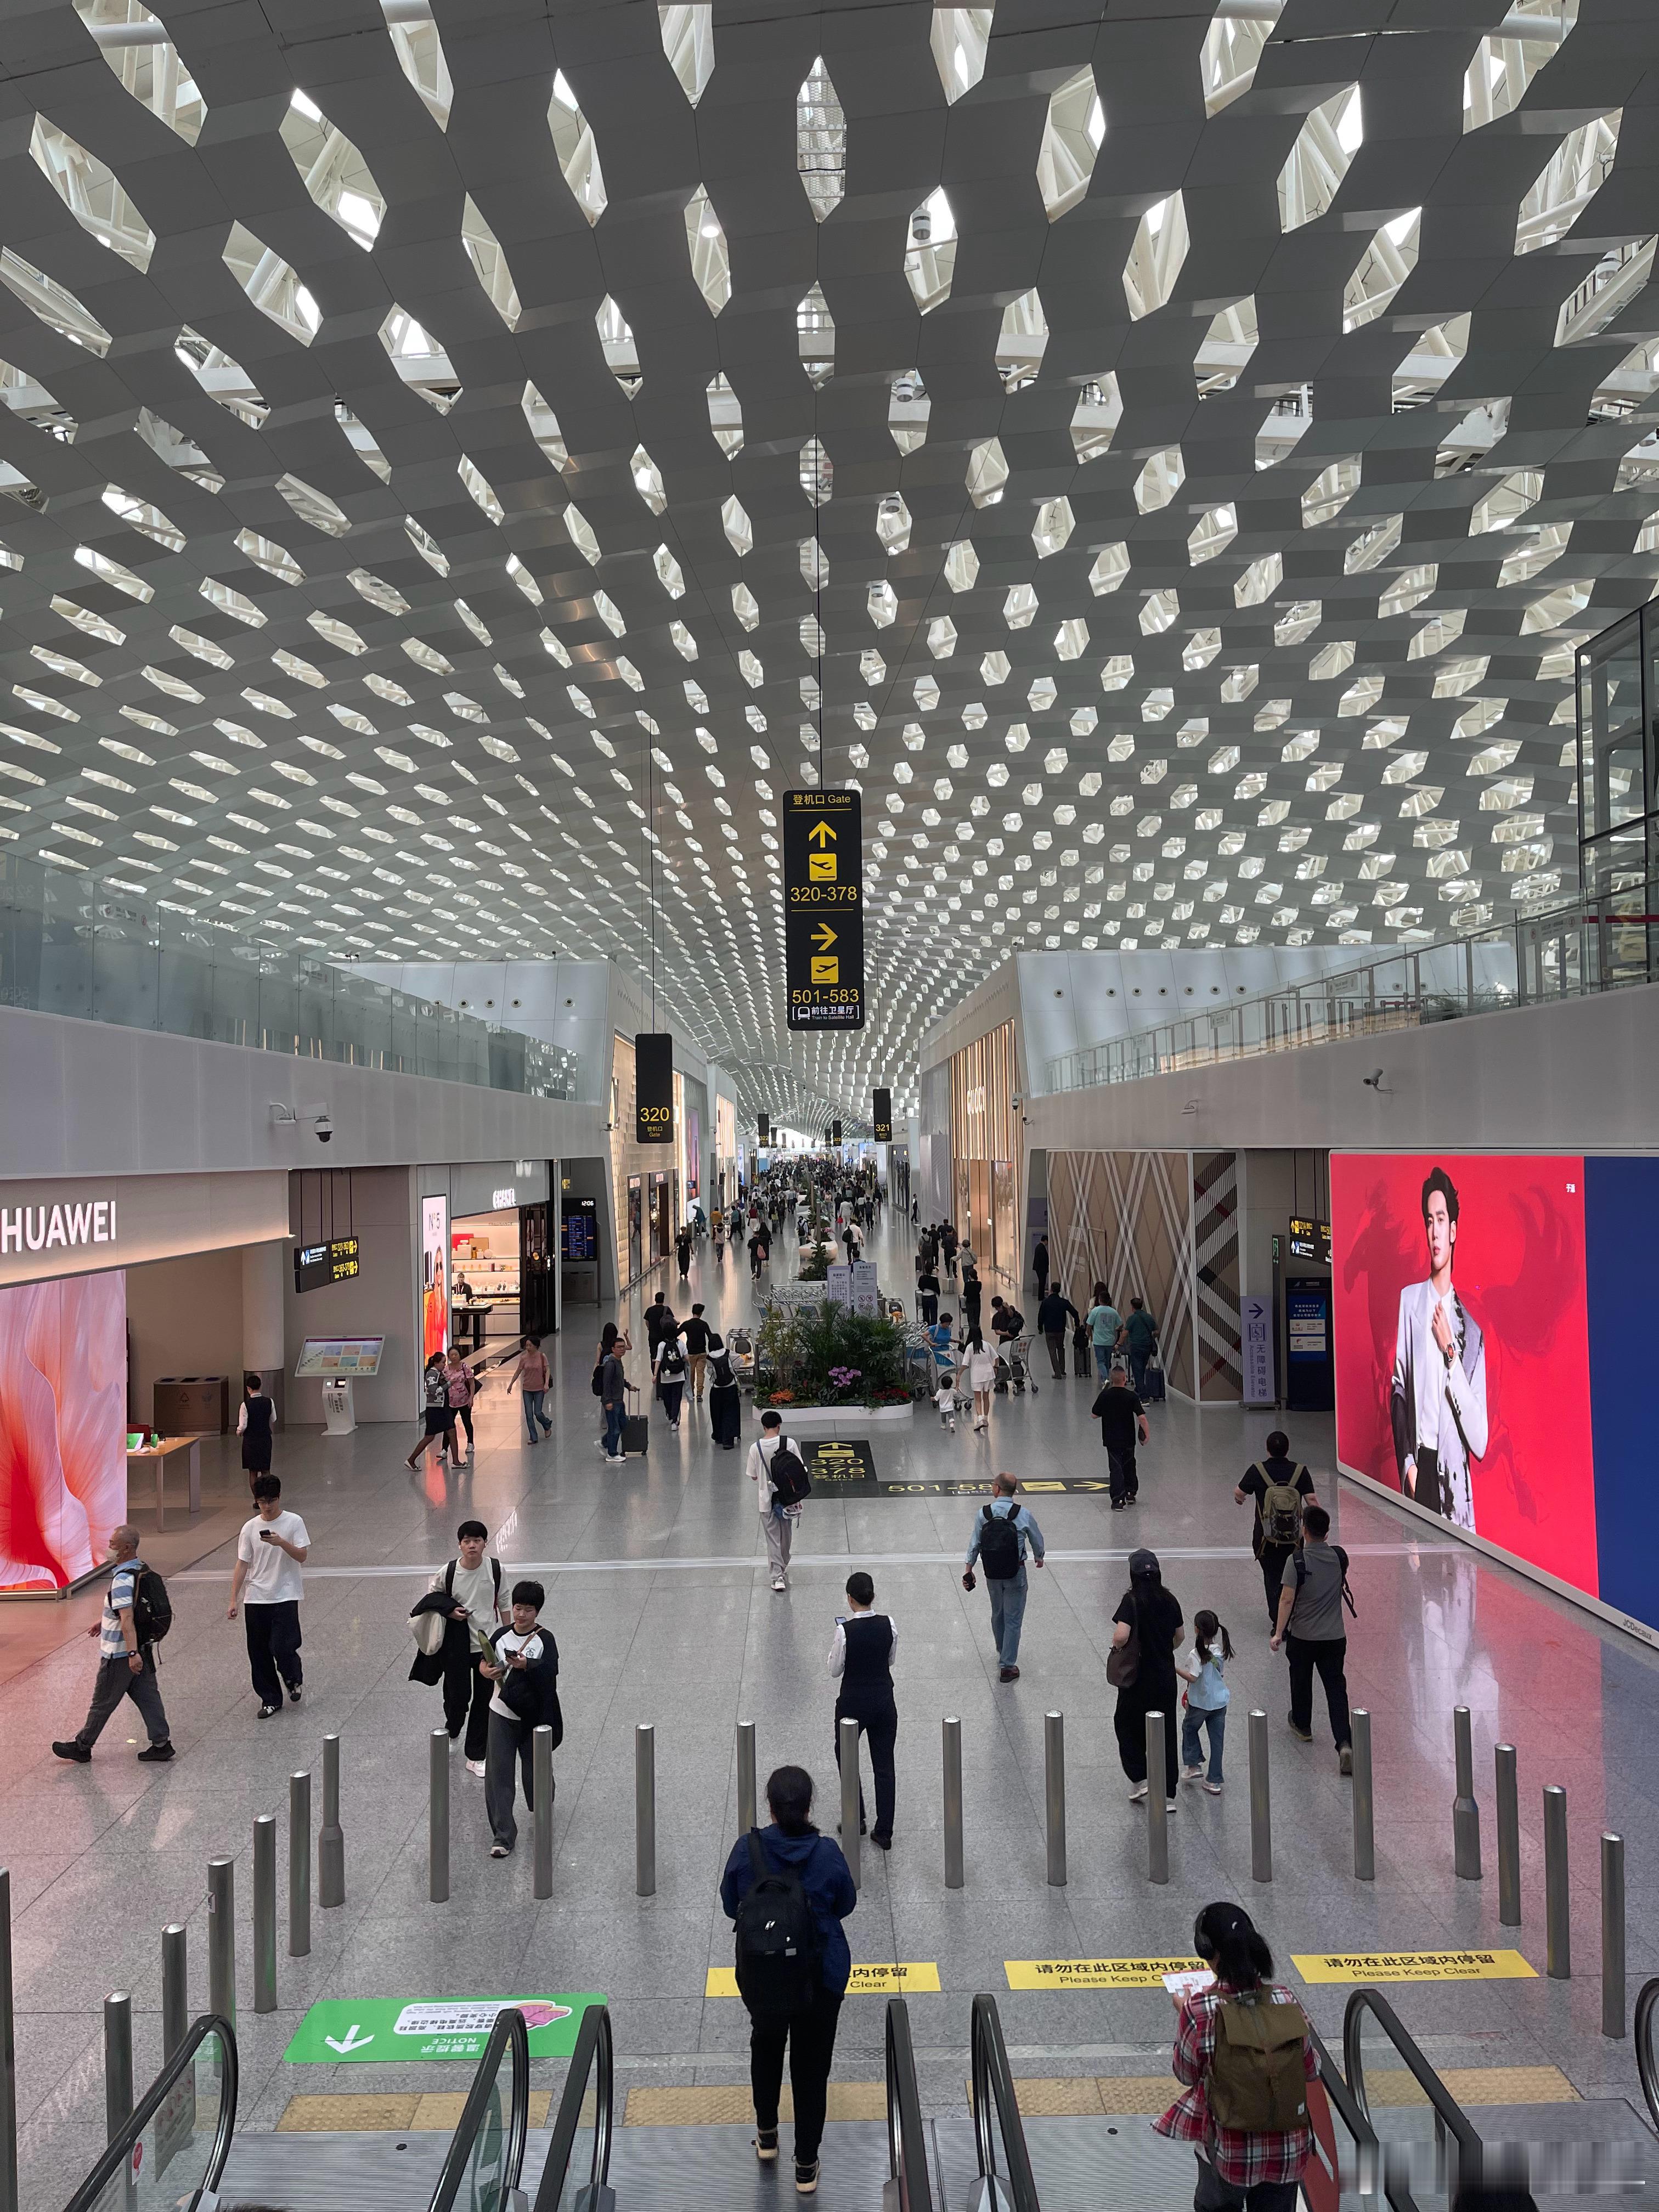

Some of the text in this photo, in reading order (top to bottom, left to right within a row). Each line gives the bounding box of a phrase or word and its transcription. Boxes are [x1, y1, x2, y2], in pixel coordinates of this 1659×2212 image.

[793, 794, 851, 805] 登机口 Gate
[790, 886, 857, 901] 320-378
[792, 989, 859, 1003] 501-583
[811, 1006, 854, 1015] 前往卫星厅
[967, 1086, 985, 1115] GUCCI
[640, 1107, 670, 1122] 320
[876, 1124, 890, 1132] 321
[1, 1201, 116, 1253] HUAWEI
[1256, 1344, 1267, 1397] 无障碍电梯
[888, 1483, 994, 1492] 501-58
[1623, 1618, 1652, 1641] JCDecaux
[1035, 1961, 1205, 1974] 请勿在此区域内停留
[1323, 1954, 1496, 1968] 请勿在此区域内停留
[850, 1967, 907, 1978] 内停留
[1111, 1975, 1148, 1983] Keep
[1403, 1968, 1440, 1977] Keep
[421, 2044, 481, 2053] 温馨提示
